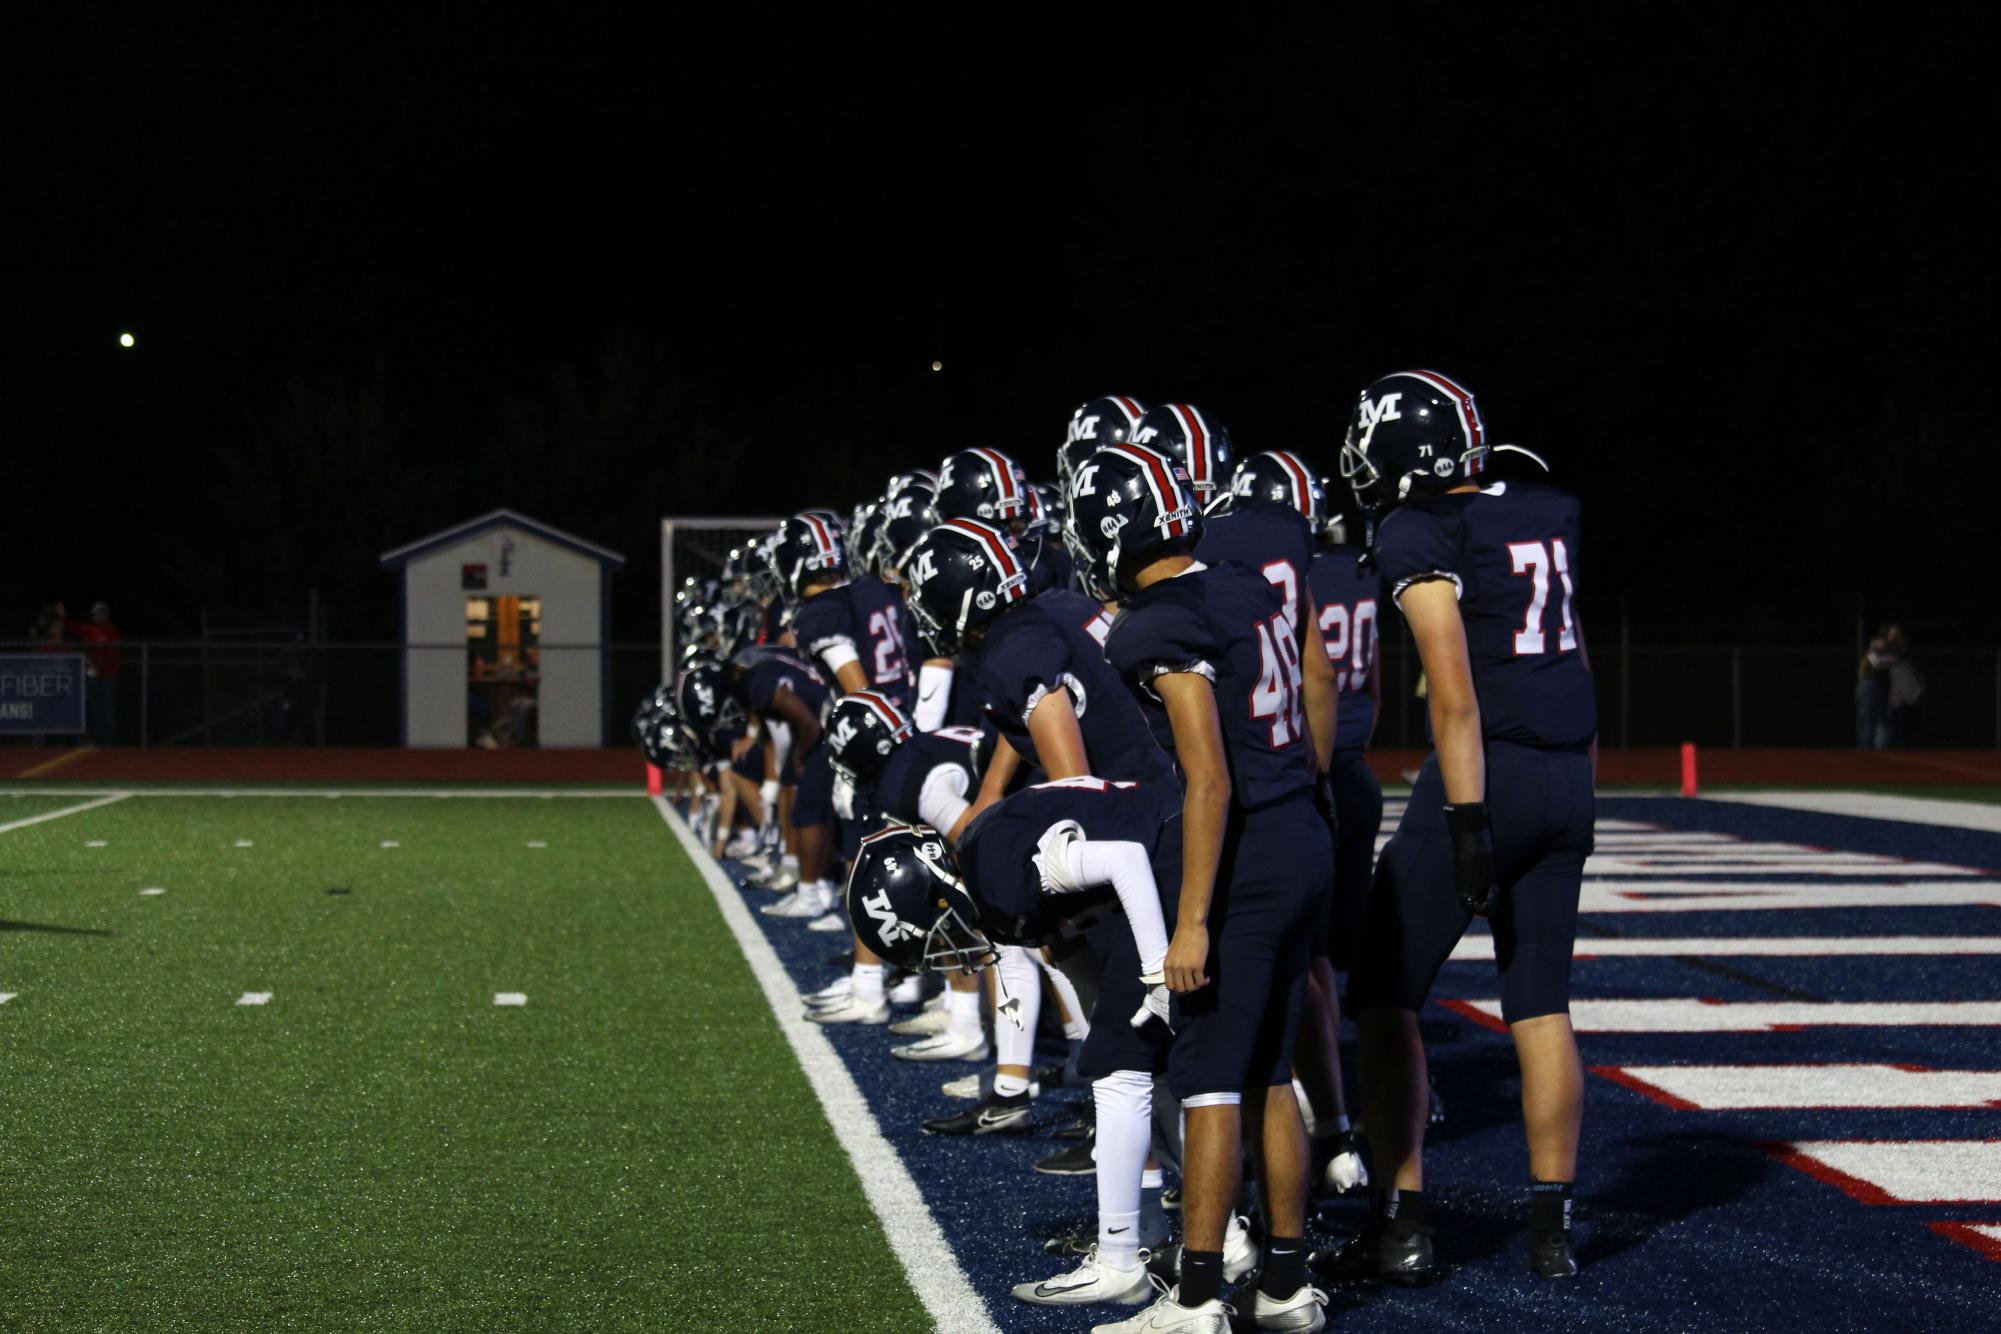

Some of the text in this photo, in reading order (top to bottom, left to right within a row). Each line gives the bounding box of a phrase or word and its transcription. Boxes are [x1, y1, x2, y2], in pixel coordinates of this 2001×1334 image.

[1358, 393, 1402, 429] M
[1069, 416, 1101, 440] M
[1418, 445, 1433, 457] 71
[1071, 465, 1100, 498] M
[1231, 473, 1257, 496] M
[886, 497, 913, 520] M
[1107, 489, 1122, 507] 48
[1159, 509, 1190, 522] XENITH
[907, 549, 939, 586] M
[968, 555, 984, 571] 25
[1505, 538, 1577, 656] 71
[1, 673, 73, 697] FIBER
[829, 716, 858, 755] M
[862, 888, 910, 948] M
